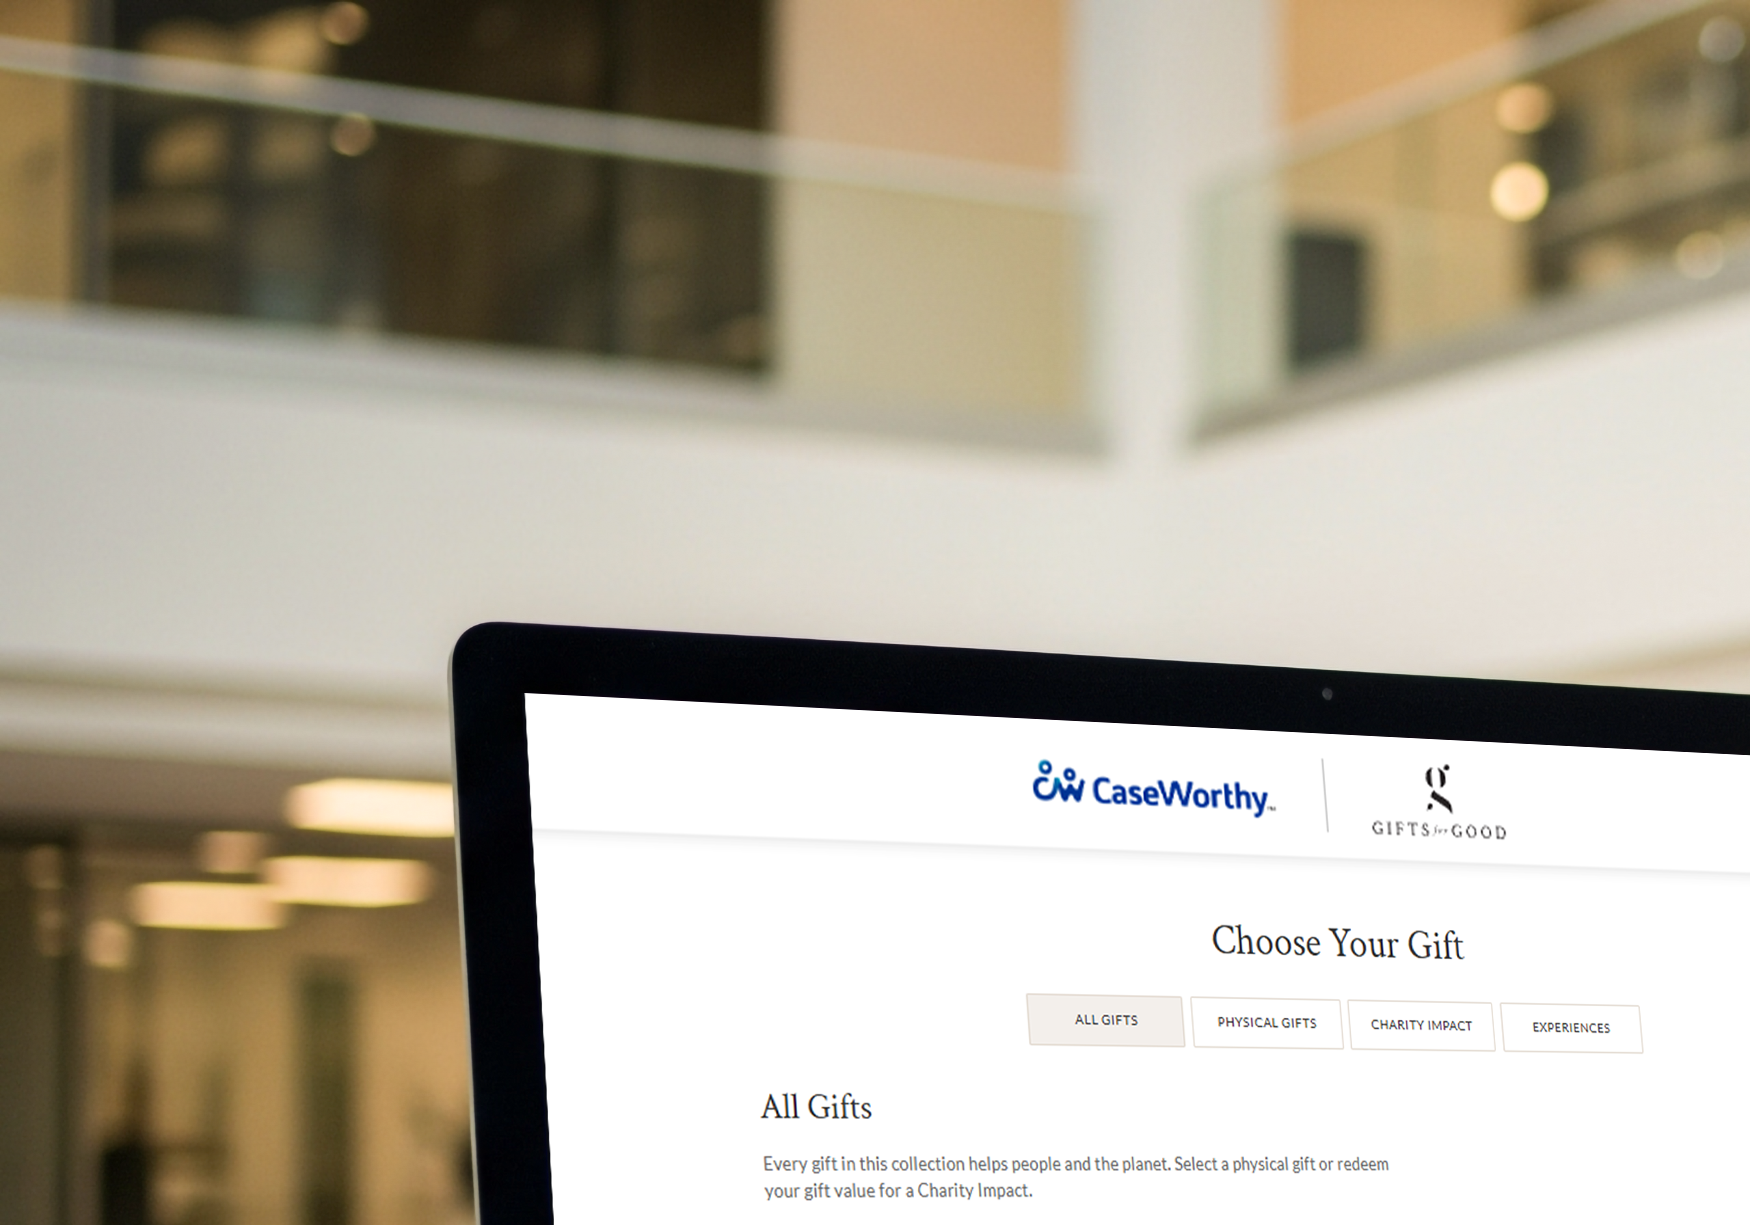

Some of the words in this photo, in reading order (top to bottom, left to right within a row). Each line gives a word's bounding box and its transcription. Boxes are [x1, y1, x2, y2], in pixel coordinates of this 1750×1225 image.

[1092, 776, 1268, 818] CaseWorthy
[1371, 820, 1430, 837] GIFTS
[1450, 823, 1507, 840] GOOD
[1212, 923, 1321, 957] Choose
[1328, 927, 1400, 959] Your
[1407, 929, 1465, 961] Gift
[1074, 1013, 1099, 1026] ALL
[1101, 1014, 1139, 1026] GIFTS
[1217, 1016, 1279, 1029] PHYSICAL
[1281, 1017, 1317, 1029] GIFTS
[1370, 1018, 1425, 1031] CHARITY
[1427, 1020, 1473, 1032] IMPACT
[1532, 1021, 1611, 1034] EXPERIENCES
[760, 1092, 800, 1120] All
[807, 1092, 873, 1120] Gifts
[763, 1155, 808, 1174] Every
[811, 1155, 839, 1174] gift
[841, 1155, 856, 1171] in
[859, 1155, 888, 1172] this
[891, 1155, 965, 1172] collection
[968, 1156, 1009, 1174] helps
[1011, 1156, 1061, 1174] people
[1064, 1156, 1091, 1172] and
[1094, 1156, 1119, 1172] the
[1122, 1156, 1172, 1174] planet.
[1174, 1155, 1219, 1172] Select
[1221, 1160, 1230, 1171] a
[1232, 1156, 1289, 1174] physical
[1292, 1156, 1317, 1174] gift
[1318, 1160, 1334, 1171] or
[1337, 1156, 1389, 1171] redeem
[764, 1186, 801, 1201] your
[804, 1182, 831, 1201] gift
[833, 1182, 876, 1198] value
[878, 1182, 902, 1198] for
[905, 1186, 915, 1198] a
[917, 1182, 974, 1201] Charity
[978, 1182, 1033, 1200] Impact.
